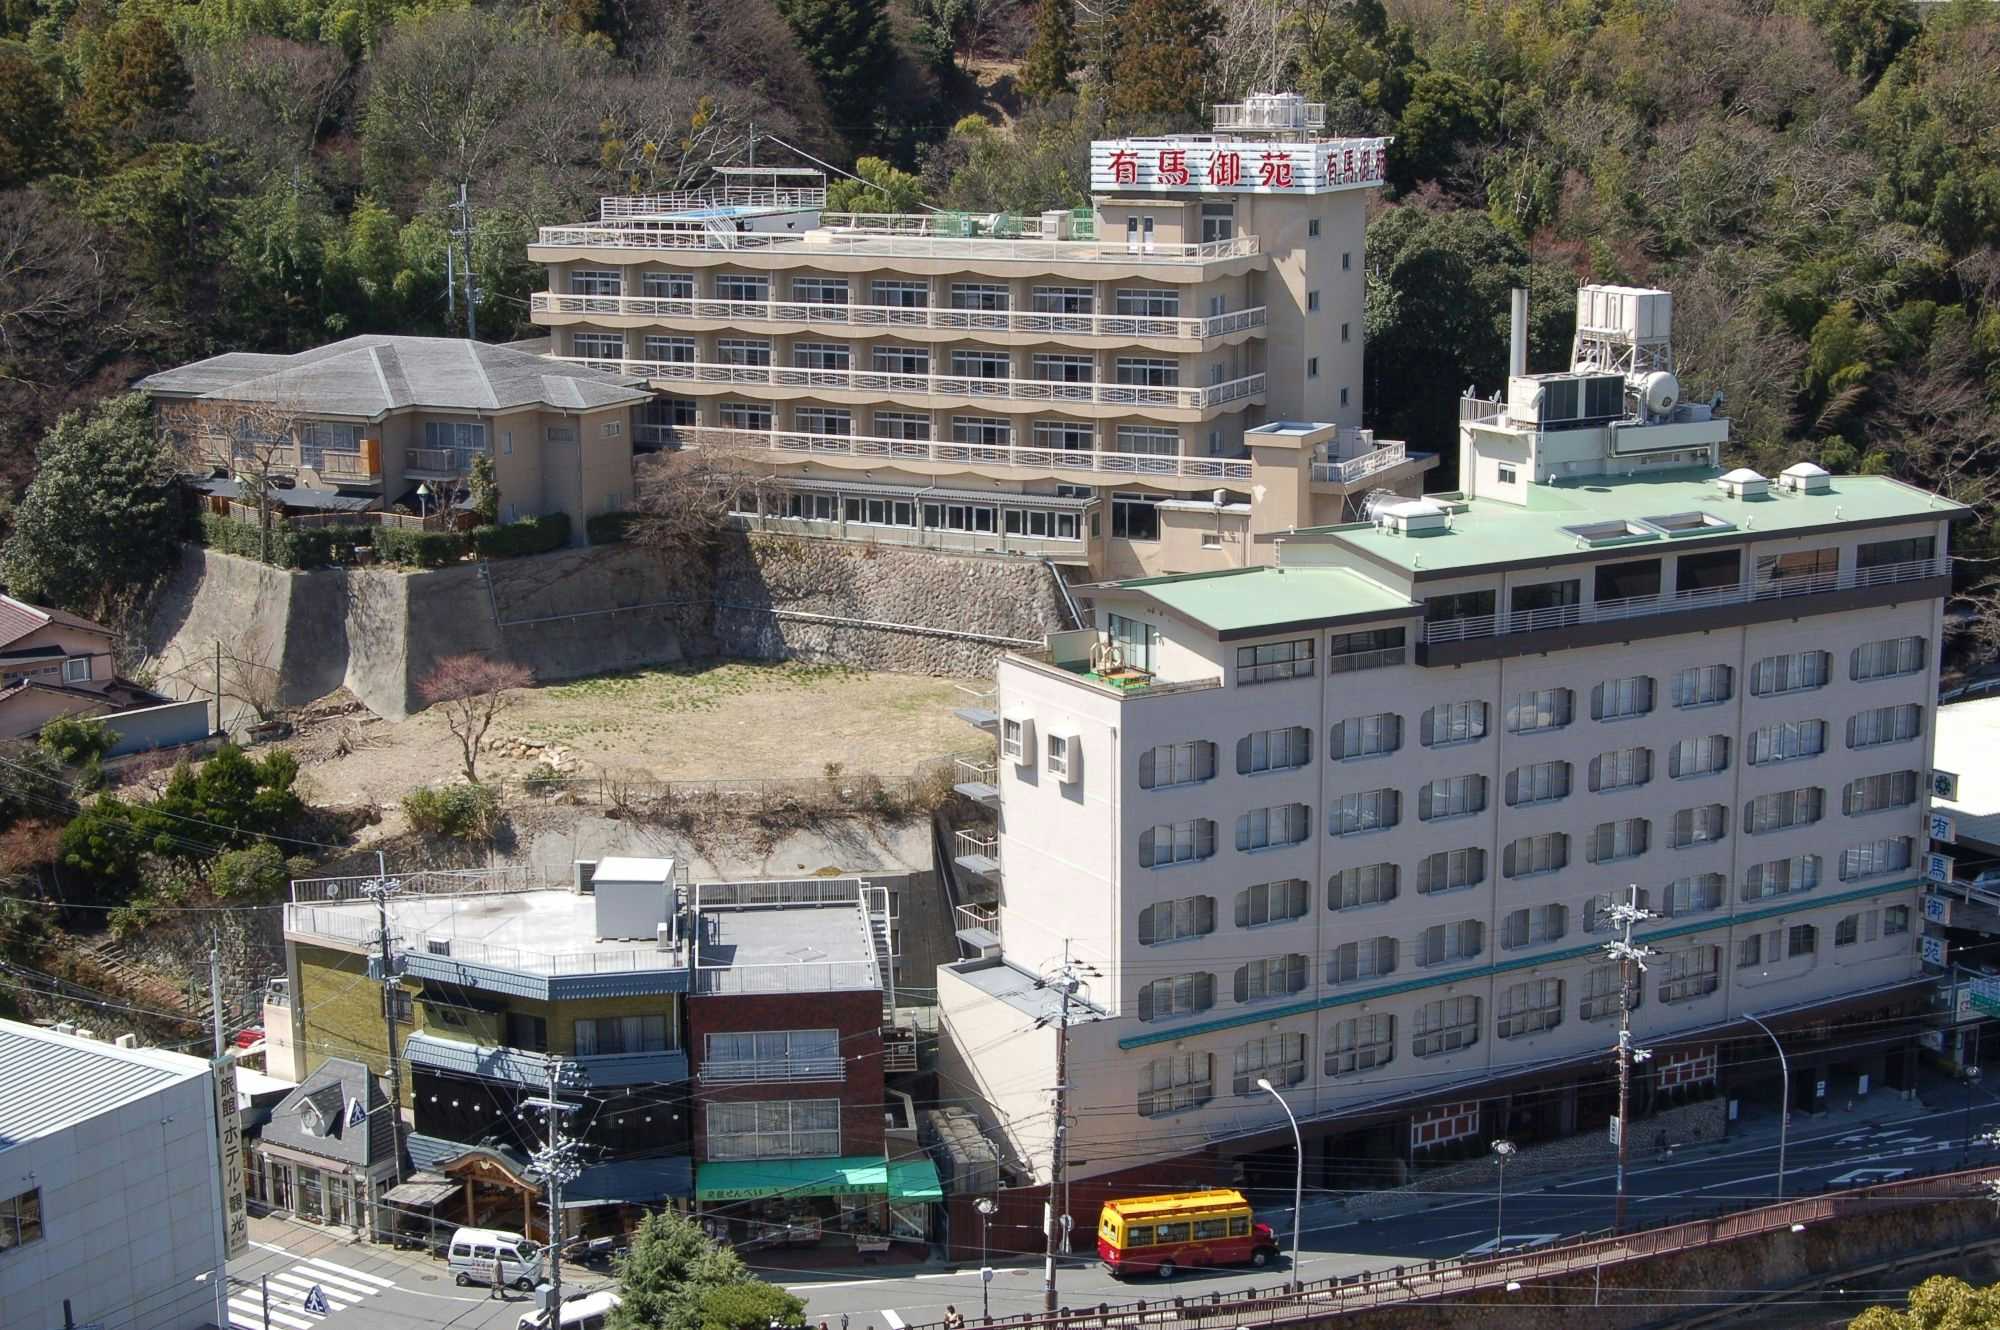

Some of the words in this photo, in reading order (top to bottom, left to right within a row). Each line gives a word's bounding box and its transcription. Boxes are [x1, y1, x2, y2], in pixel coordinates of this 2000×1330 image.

[1107, 149, 1293, 188] 有馬御苑
[1326, 146, 1386, 186] 有馬御苑
[1923, 816, 1949, 963] 有馬御苑
